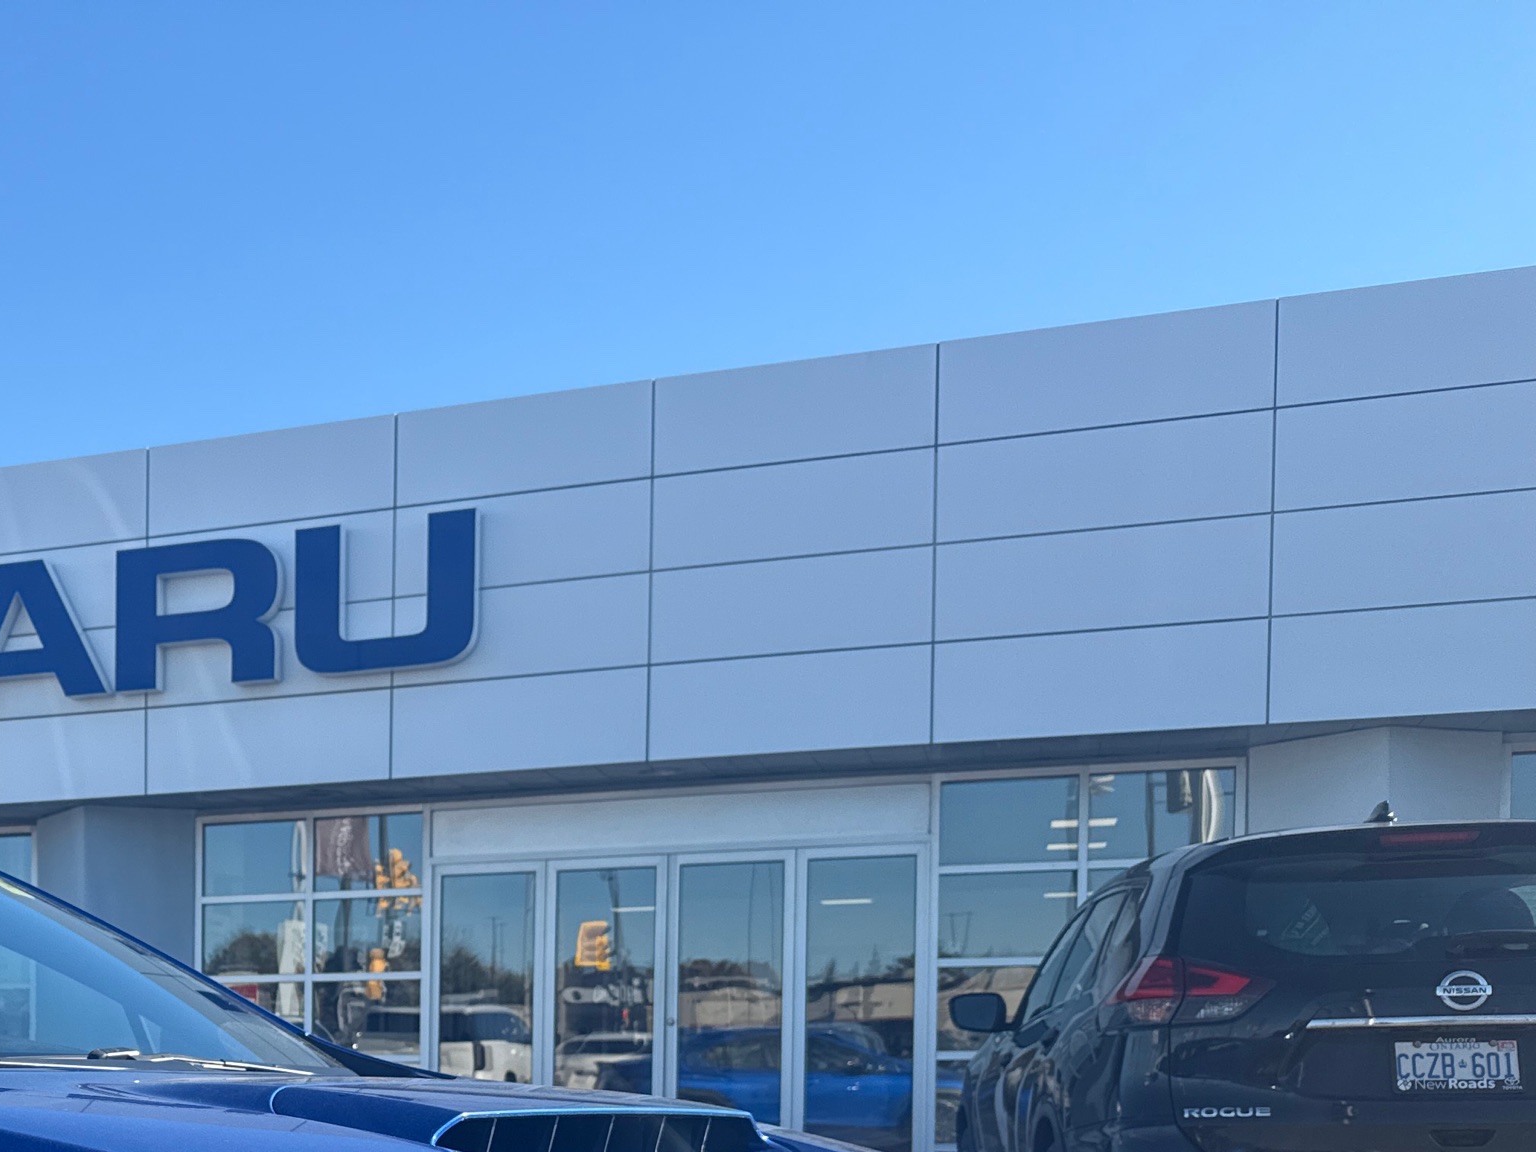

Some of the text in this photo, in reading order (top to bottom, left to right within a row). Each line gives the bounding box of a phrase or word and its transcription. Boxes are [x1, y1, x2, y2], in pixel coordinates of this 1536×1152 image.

[1442, 986, 1488, 995] NISSAN
[1435, 1036, 1476, 1044] Aurora
[1429, 1042, 1480, 1051] ONTARIO
[1397, 1052, 1515, 1080] CCZB 601
[1183, 1106, 1271, 1118] ROGUE
